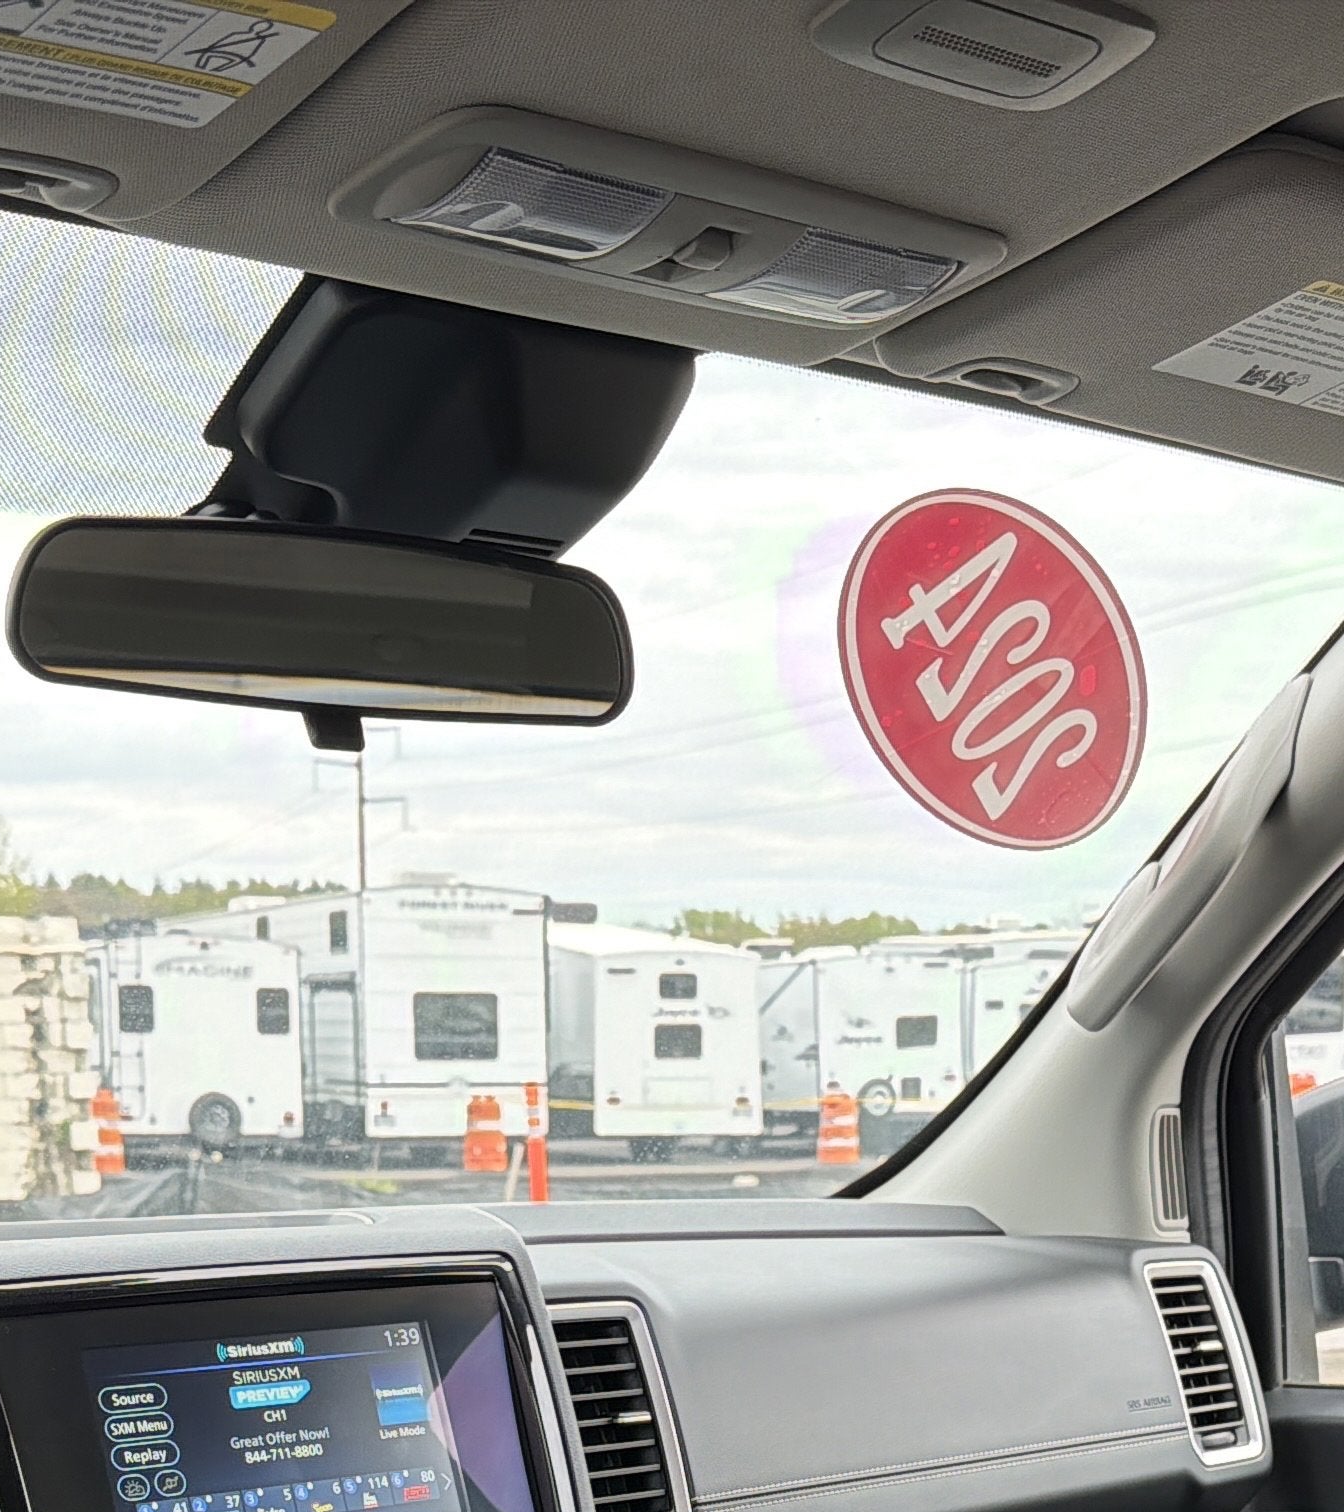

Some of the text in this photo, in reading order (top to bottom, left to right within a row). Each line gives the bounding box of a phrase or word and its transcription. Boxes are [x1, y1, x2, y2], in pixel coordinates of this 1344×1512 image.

[383, 1327, 420, 1347] 1:39
[232, 1366, 301, 1385] SIRIUSXM
[111, 1391, 155, 1407] Source
[236, 1384, 304, 1404] PREVIEW
[263, 1408, 288, 1423] CH1
[109, 1419, 168, 1436] SXM Menu
[379, 1424, 427, 1440] Live Mode
[230, 1426, 331, 1450] Great Offer Now!
[123, 1447, 167, 1465] Replay
[244, 1443, 324, 1465] 844-711-8800
[367, 1476, 389, 1490] 114
[420, 1469, 436, 1483] 80
[282, 1488, 293, 1501] 5
[331, 1481, 342, 1495] 6
[224, 1494, 241, 1509] 37
